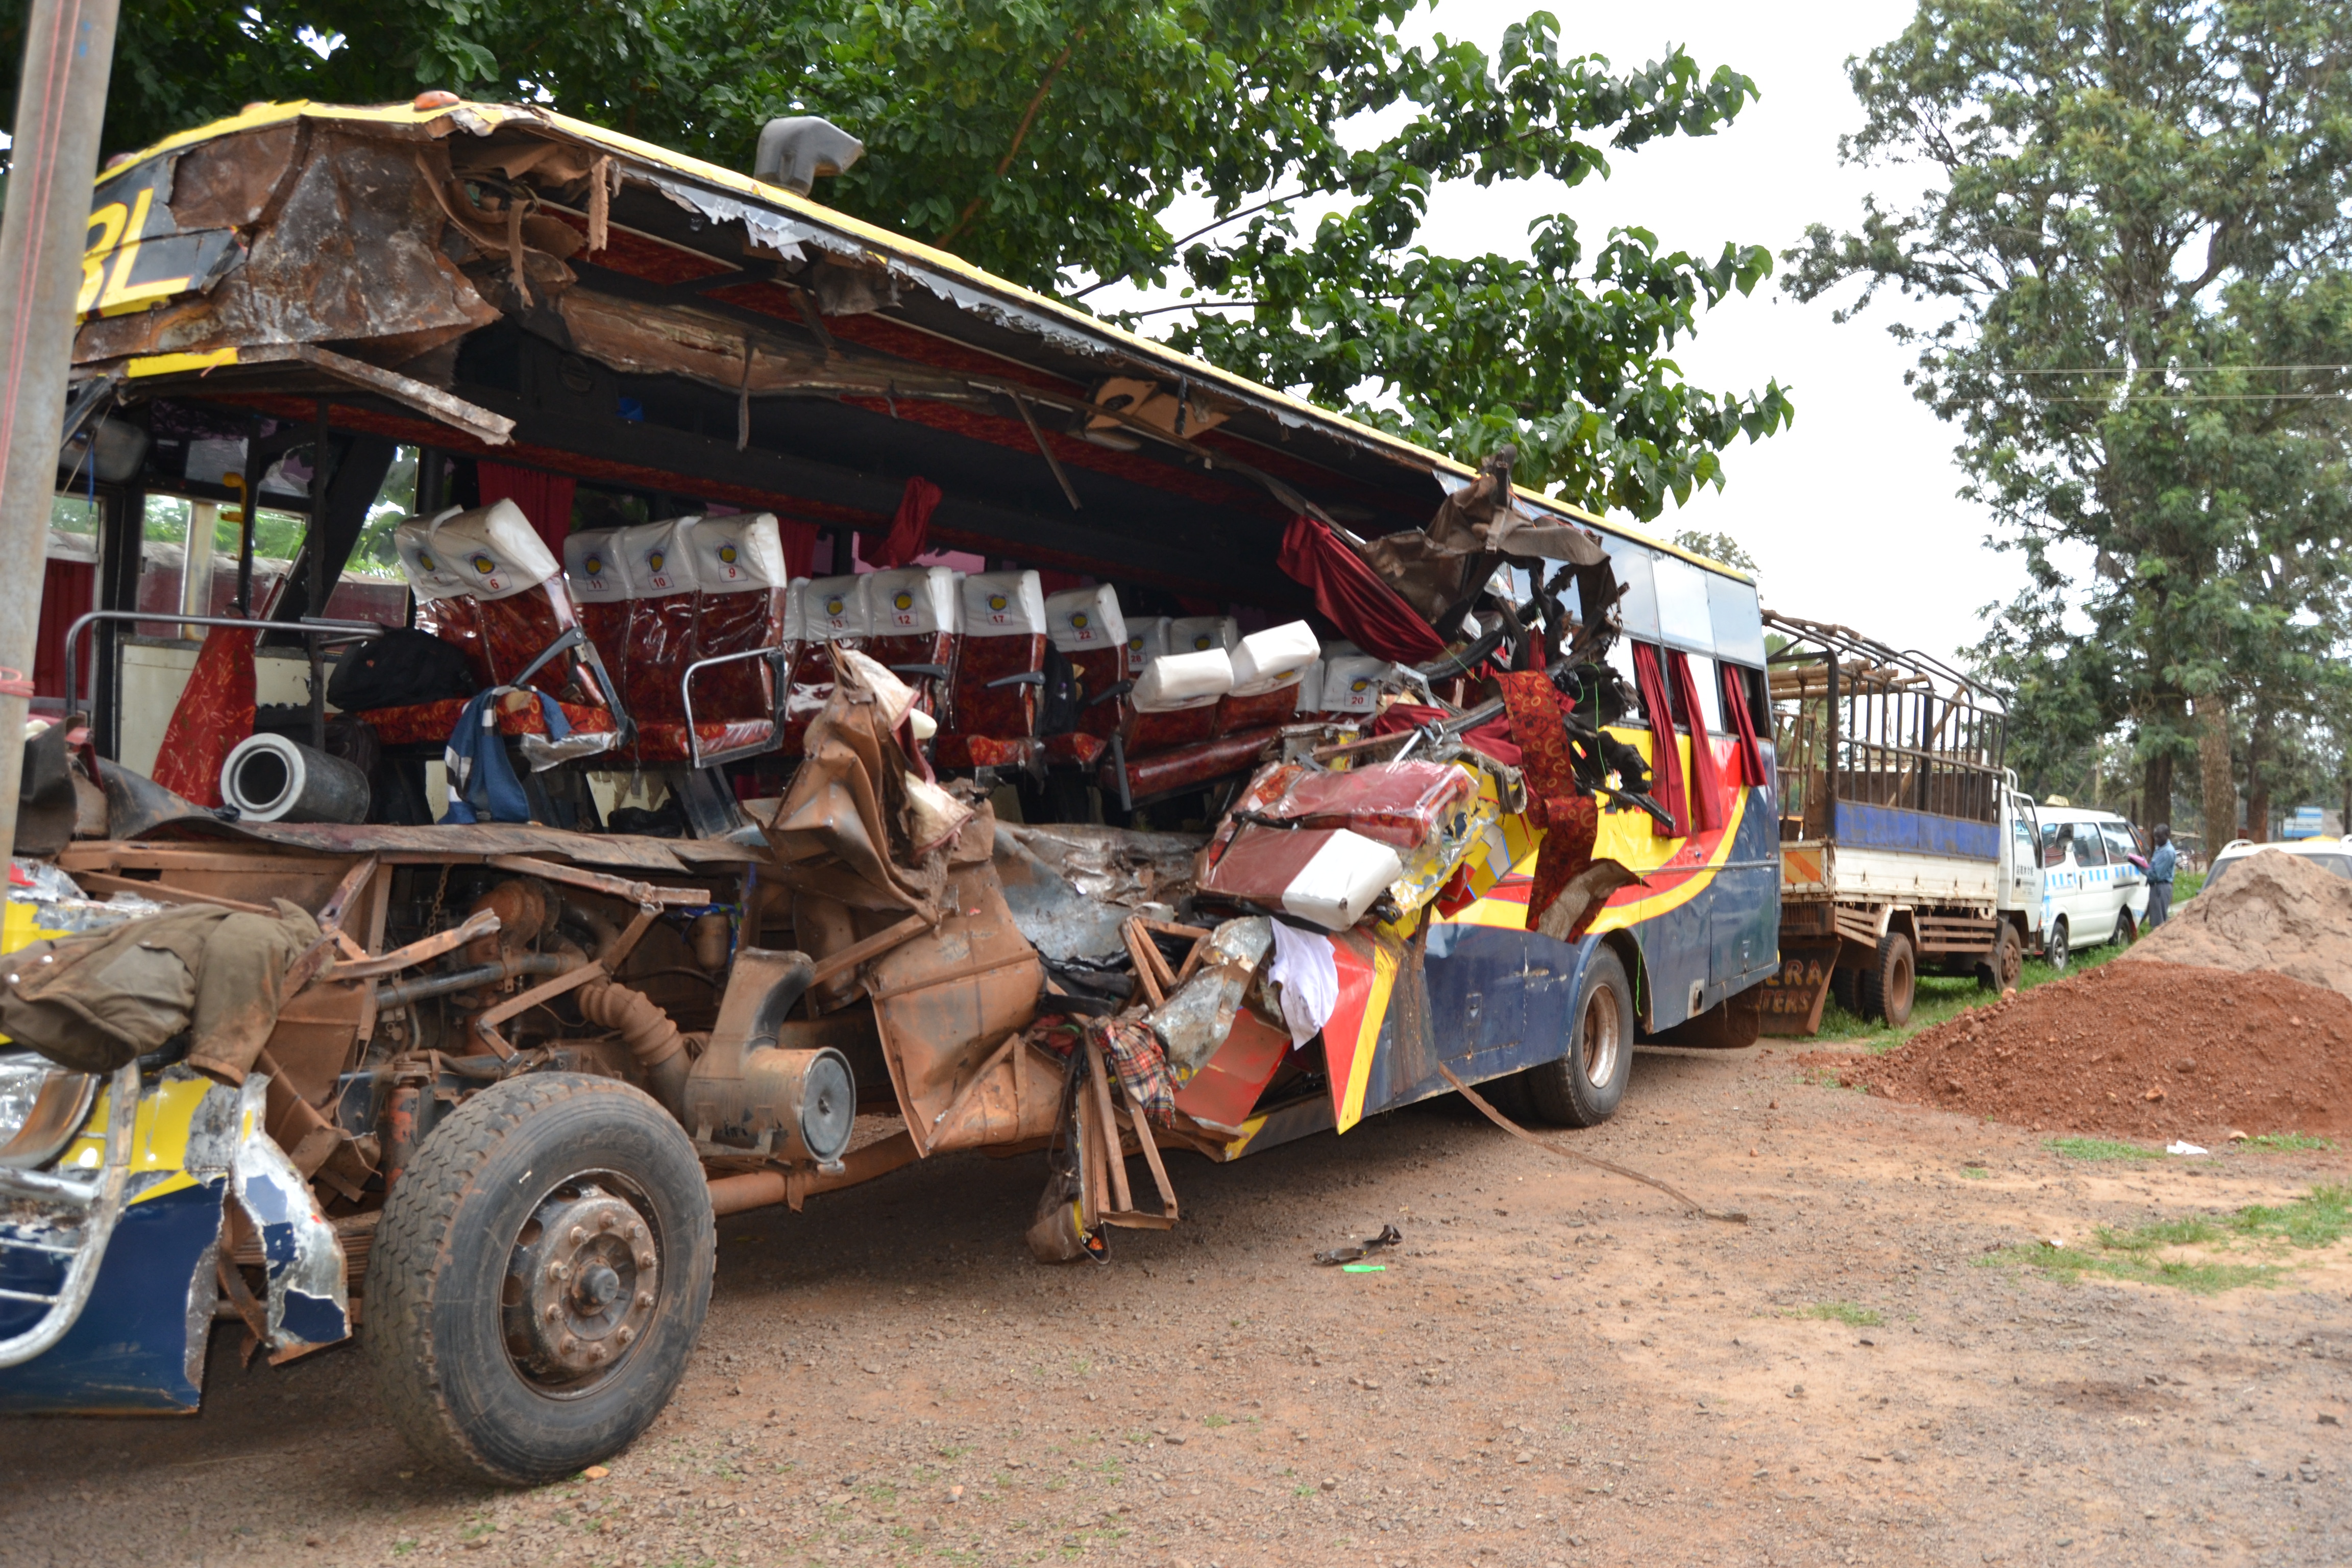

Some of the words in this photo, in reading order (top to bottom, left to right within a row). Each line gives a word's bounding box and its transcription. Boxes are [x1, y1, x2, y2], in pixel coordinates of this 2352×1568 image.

[729, 567, 736, 578] 9
[490, 578, 500, 589] 6
[591, 580, 602, 589] 11
[653, 577, 666, 587] 10
[898, 615, 911, 624] 12
[992, 615, 1004, 623] 17
[832, 620, 842, 629] 13
[1079, 631, 1092, 639] 22
[1351, 696, 1364, 705] 20
[1756, 990, 1811, 1013] TERS
